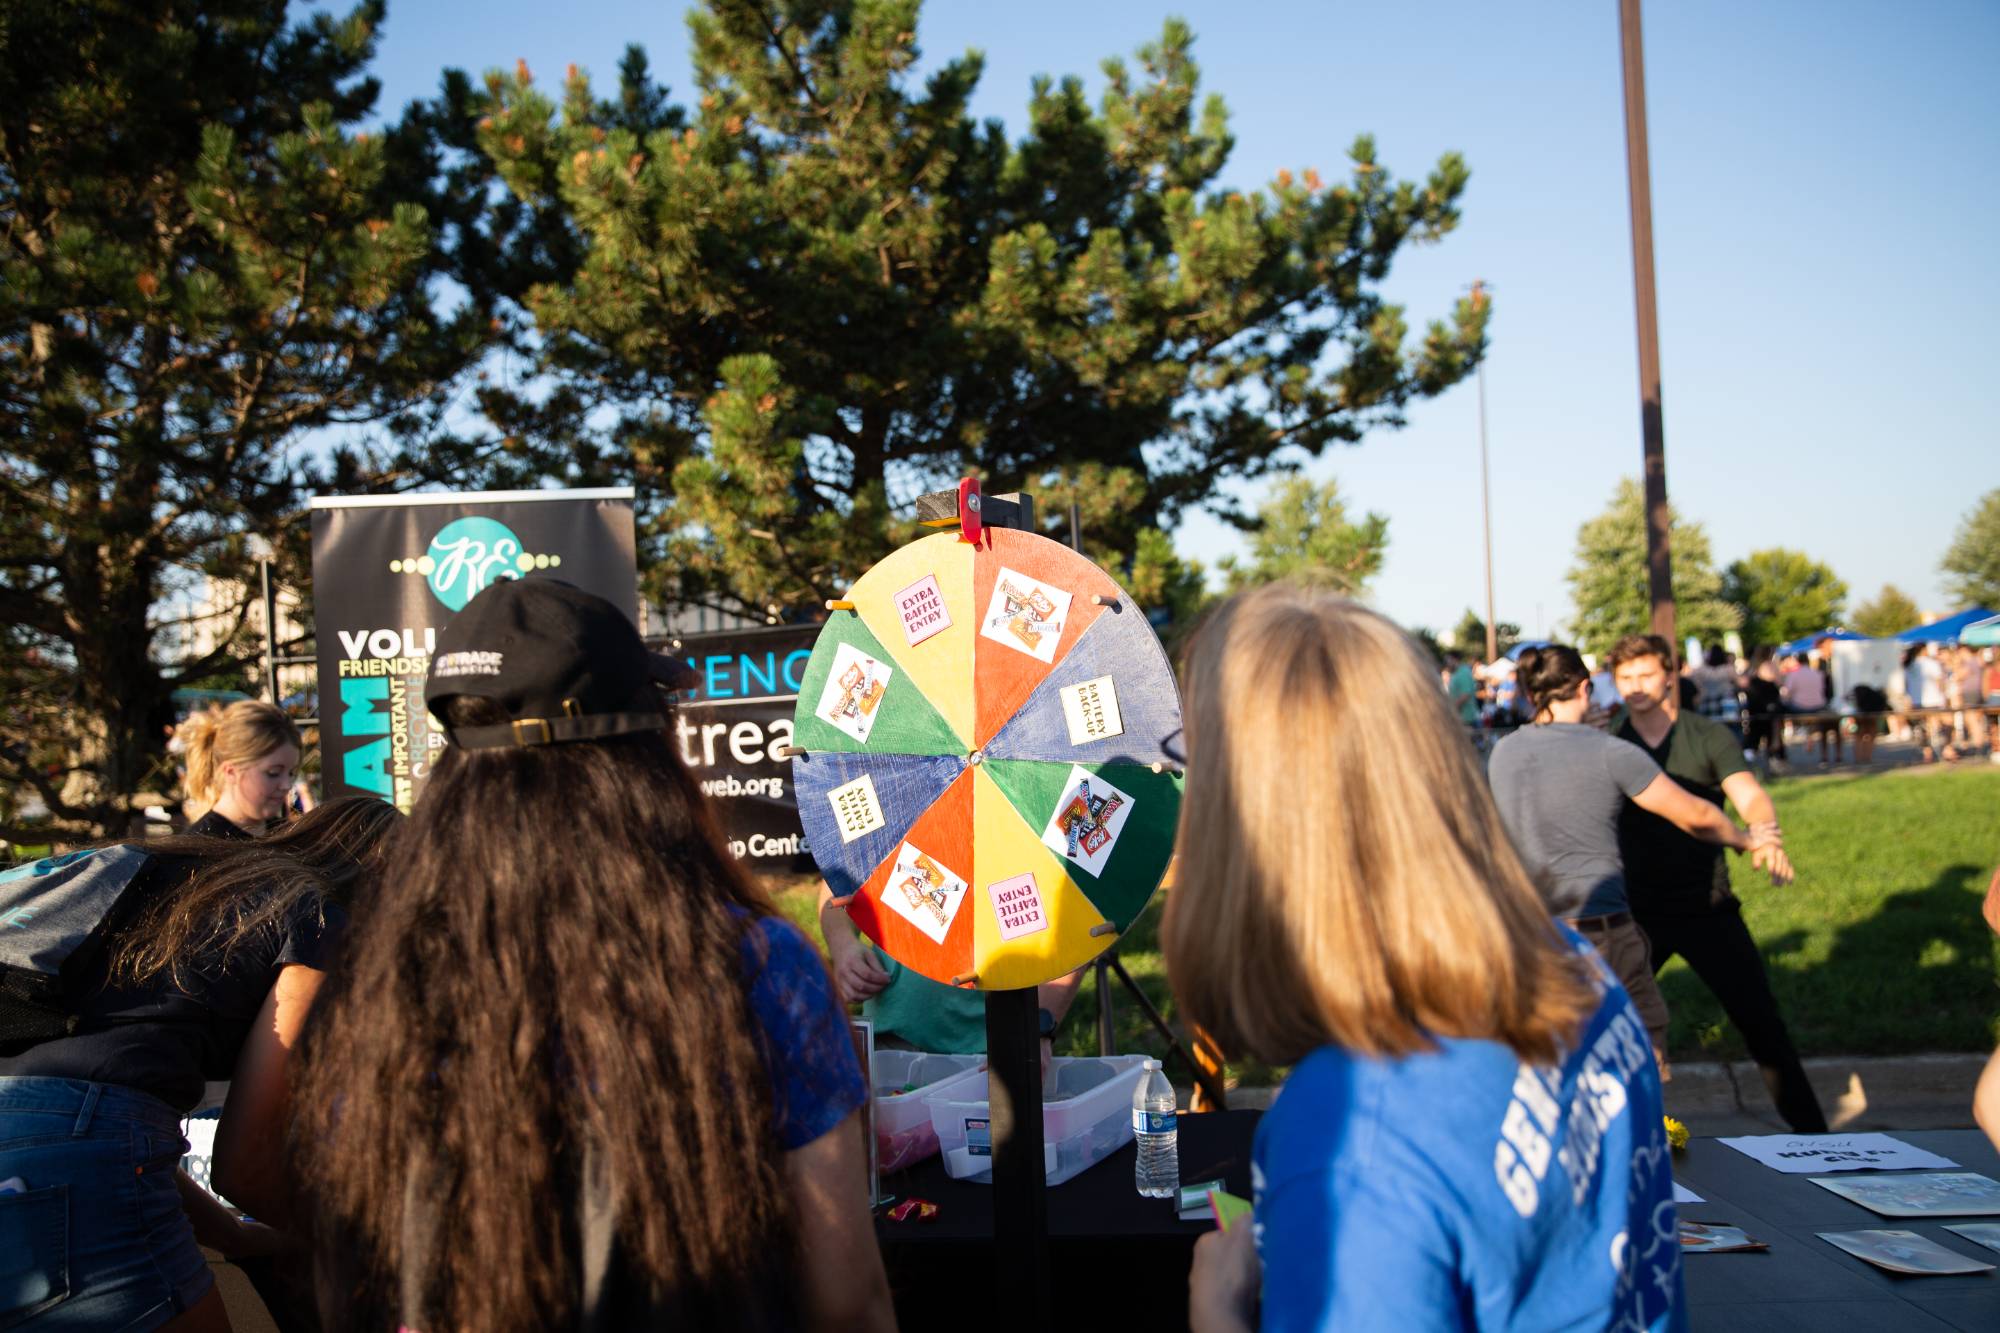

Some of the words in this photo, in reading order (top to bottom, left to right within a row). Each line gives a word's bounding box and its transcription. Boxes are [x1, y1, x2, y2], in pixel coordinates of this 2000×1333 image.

[902, 586, 934, 610] EXTRA
[904, 596, 940, 622] RAFFLE
[910, 608, 942, 633] ENTRY
[389, 677, 409, 776] IMPORTANT
[407, 677, 427, 762] RECYCLE
[1078, 687, 1095, 736] BACK-UP
[1089, 683, 1106, 734] BATTERY
[838, 794, 856, 832] EXTRA
[846, 786, 866, 830] RAFFLE
[855, 787, 874, 824] ENTRY
[998, 885, 1032, 904] ENTRY
[999, 897, 1038, 917] RAFFLE
[1004, 910, 1039, 928] EXTRA
